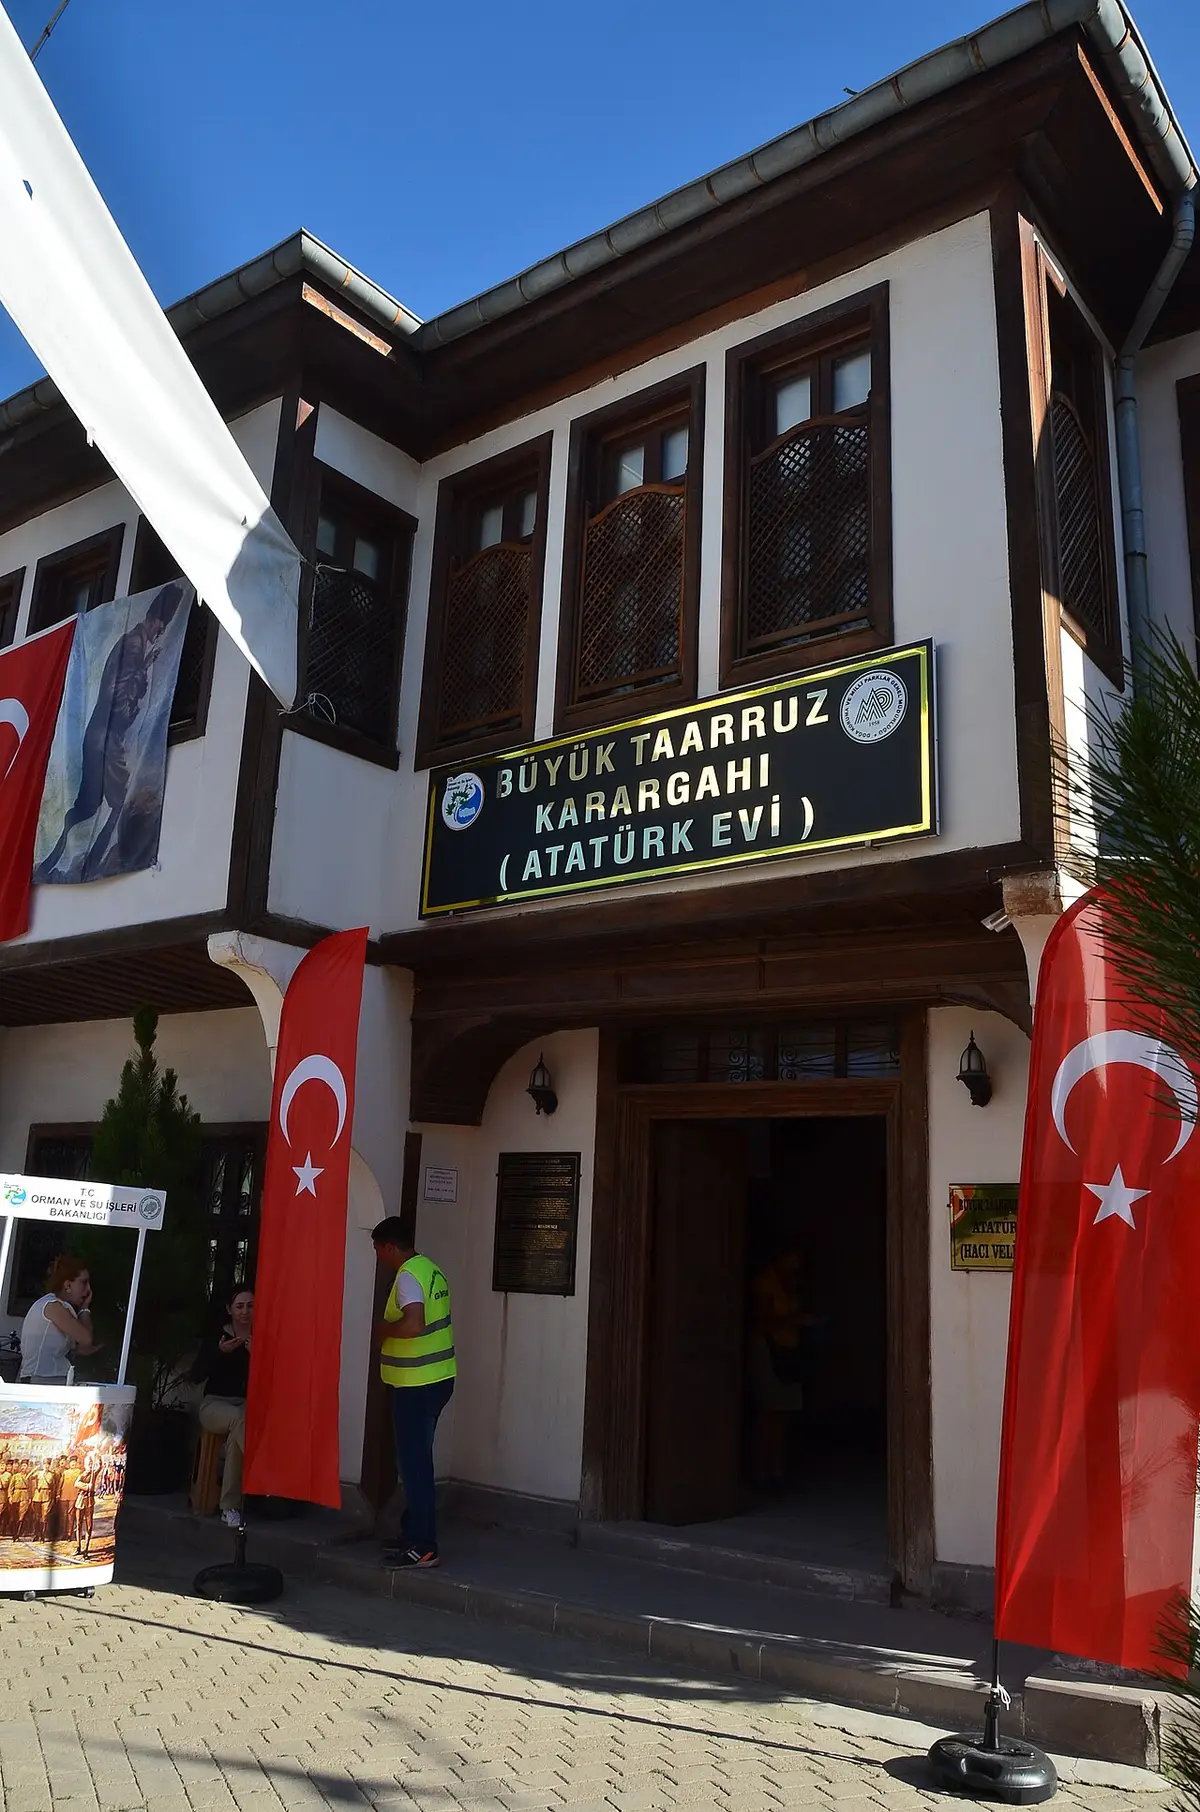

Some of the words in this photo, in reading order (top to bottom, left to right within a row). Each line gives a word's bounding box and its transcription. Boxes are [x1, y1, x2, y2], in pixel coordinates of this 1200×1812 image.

[496, 742, 616, 799] BÜYÜK
[630, 688, 829, 766] TAARRUZ
[535, 753, 769, 834] KARARGAHI
[522, 819, 694, 881] ATATÜRK
[712, 794, 780, 847] EVİ
[80, 1187, 95, 1197] T.C
[31, 1194, 70, 1207] ORMAN
[73, 1199, 86, 1208] VE
[89, 1200, 103, 1210] SU
[105, 1199, 137, 1213] İŞLERİ
[972, 1217, 1017, 1234] ATATÜR
[960, 1243, 990, 1261] (HACI
